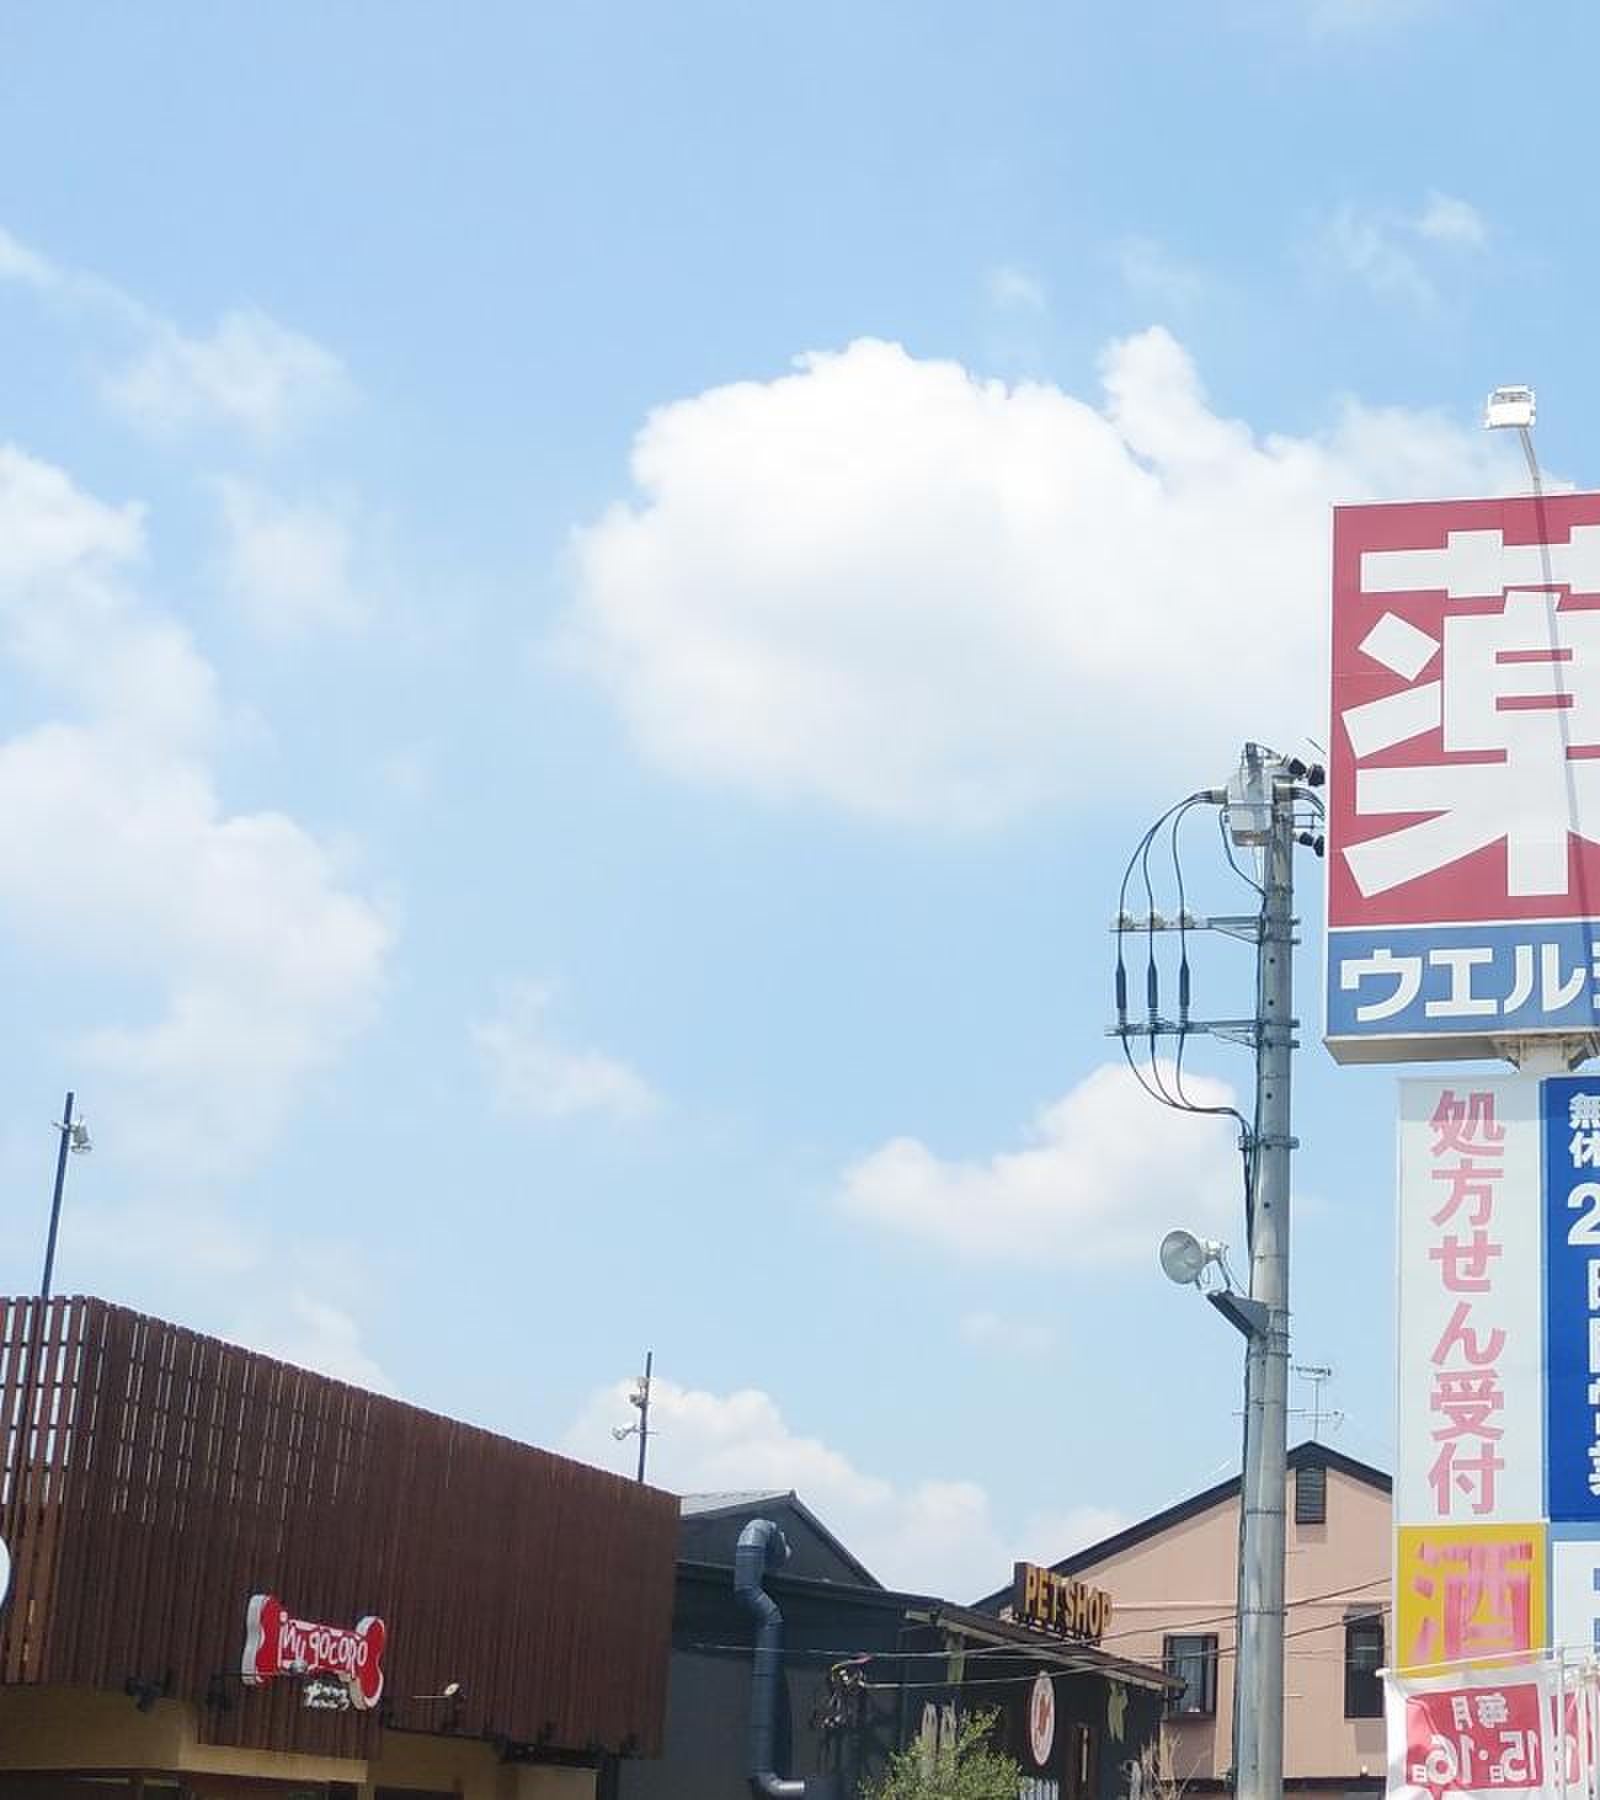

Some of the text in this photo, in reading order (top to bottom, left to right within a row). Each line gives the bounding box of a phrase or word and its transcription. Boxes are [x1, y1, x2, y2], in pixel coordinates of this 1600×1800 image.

[1427, 1089, 1508, 1516] 処方せん受付
[1024, 1566, 1113, 1634] PET SHOP
[1412, 1540, 1534, 1666] 酒
